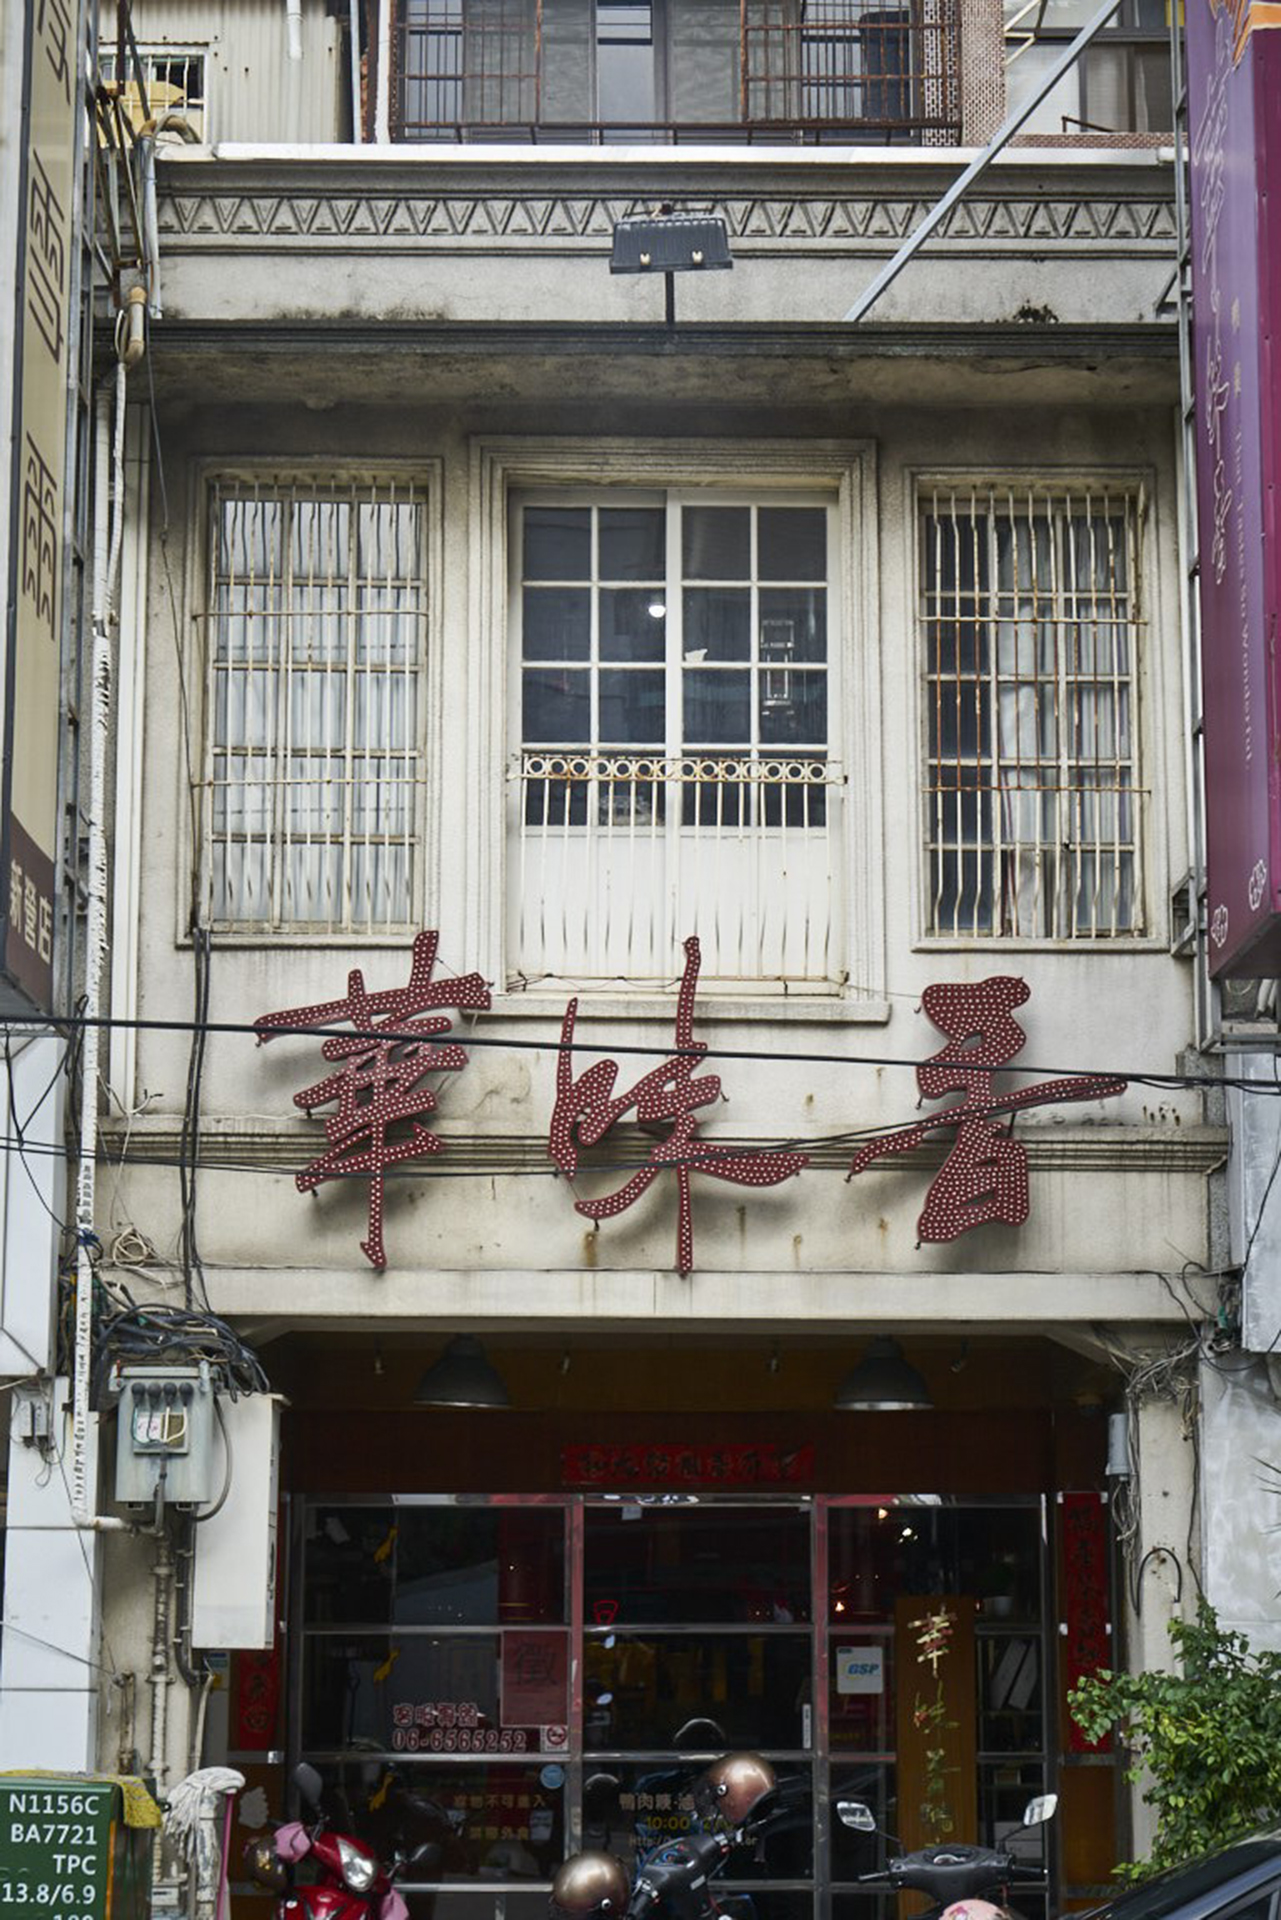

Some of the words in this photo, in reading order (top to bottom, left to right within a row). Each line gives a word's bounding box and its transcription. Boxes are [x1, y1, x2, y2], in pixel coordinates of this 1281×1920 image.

[847, 1663, 880, 1676] GSP
[391, 1727, 528, 1751] 06-6565252
[9, 1794, 100, 1815] N1156C
[11, 1823, 98, 1845] BA7721
[647, 1816, 691, 1831] 10:00
[53, 1854, 97, 1875] TPC
[2, 1882, 96, 1906] 13.8/6.9
